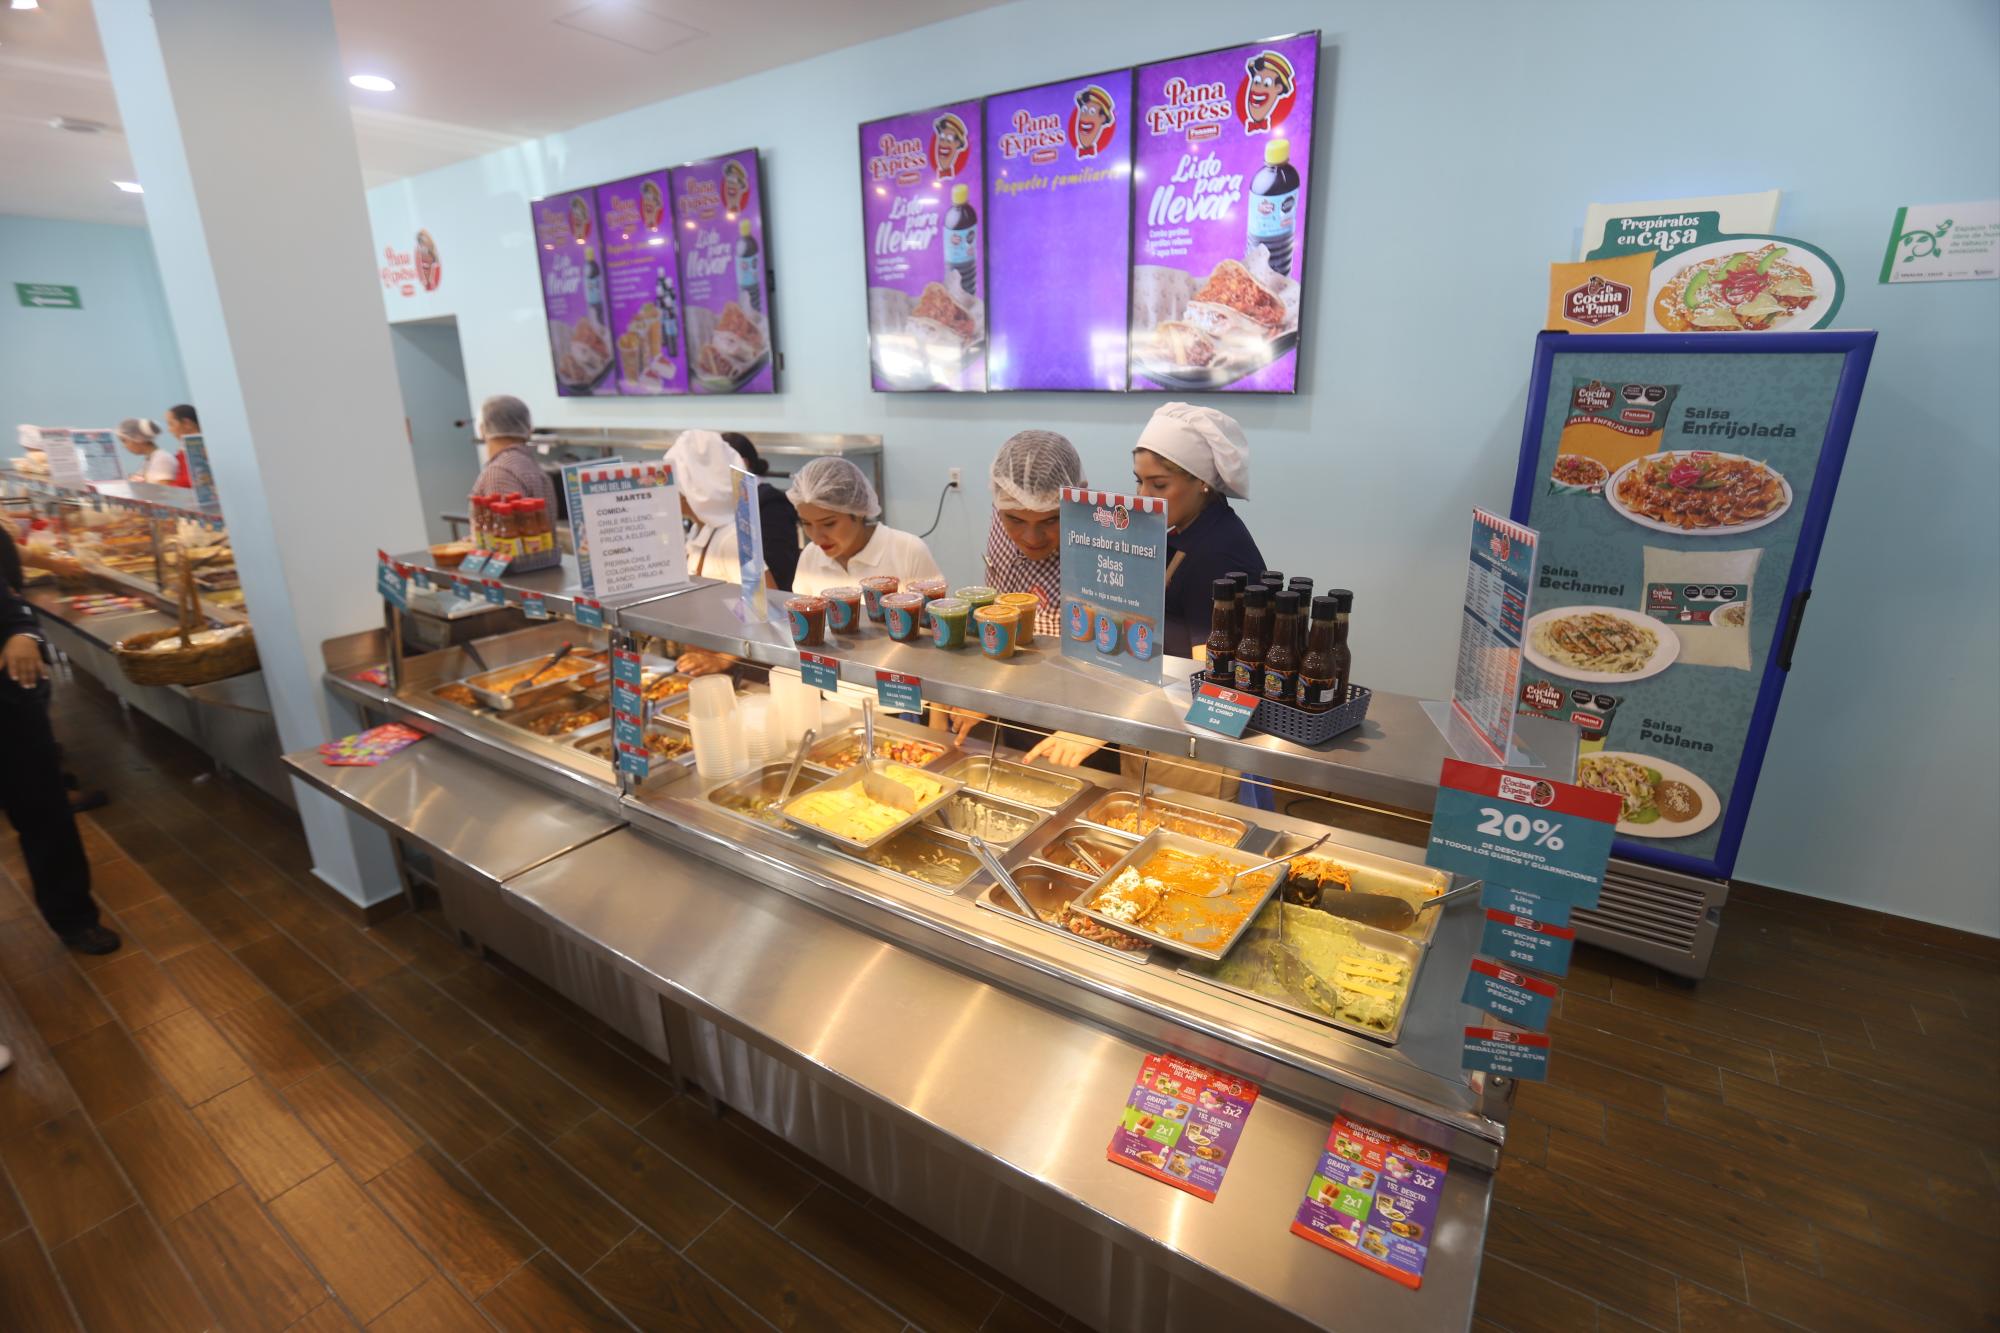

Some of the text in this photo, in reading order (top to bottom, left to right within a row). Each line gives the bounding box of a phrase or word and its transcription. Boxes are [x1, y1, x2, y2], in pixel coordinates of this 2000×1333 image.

[1165, 79, 1224, 105] Pana
[1013, 110, 1059, 133] Pana
[1147, 101, 1231, 134] Express
[880, 134, 922, 156] Pana
[1000, 131, 1064, 157] Express
[869, 154, 926, 179] Express
[1171, 152, 1221, 181] Listo
[995, 175, 1048, 195] Paquetes
[1194, 174, 1242, 200] para
[1148, 184, 1240, 225] llevar
[903, 213, 938, 232] para
[1620, 214, 1699, 230] Prepáralos
[875, 221, 938, 255] llevar
[1617, 228, 1697, 251] en casa
[1572, 291, 1622, 305] Cocina
[1572, 303, 1622, 316] del Pana
[1579, 389, 1610, 398] Cocina
[1684, 407, 1730, 419] Salsa
[1593, 416, 1645, 435] ENFRIJOLADA
[1681, 420, 1796, 438] Enfrijolada
[615, 492, 651, 502] MARTES
[599, 525, 623, 535] ARROZ
[1068, 530, 1156, 558] ¡Ponle sabor a tu mesa!
[1097, 554, 1123, 572] Salsas
[1541, 564, 1578, 577] Salsa
[1096, 569, 1123, 587] 2 x $40
[1539, 576, 1624, 596] Bechamel
[1526, 685, 1559, 699] Cocina
[1197, 696, 1250, 715] SALSA MARISQUERA
[1215, 708, 1233, 716] CHINO
[1641, 718, 1681, 732] Salsa
[1639, 729, 1713, 751] Poblana
[1501, 785, 1530, 797] Express
[1503, 776, 1531, 790] Cocina
[1476, 807, 1564, 850] 20%
[1432, 836, 1445, 844] EN
[1445, 839, 1472, 851] TODOS
[1473, 846, 1489, 856] LOS
[1490, 850, 1521, 864] GUISOS
[1530, 861, 1598, 883] GUARNICIONES
[1482, 842, 1546, 862] DE DESCUENTO
[1501, 928, 1551, 947] CEVICHE DE
[1513, 939, 1536, 950] SOYA
[1484, 979, 1533, 1001] CEVICHE DE
[1487, 987, 1526, 1006] PESCADO
[1481, 1039, 1530, 1052] CEVICHE DE
[1509, 1050, 1522, 1058] DE
[1168, 1062, 1207, 1079] PROMOCIONES
[1173, 1070, 1197, 1082] DEL MES
[1146, 1094, 1167, 1105] GRATIS
[1222, 1105, 1242, 1118] 3x2
[1156, 1124, 1174, 1136] 2x1
[1345, 1121, 1391, 1142] PROMOCIONES
[1352, 1130, 1379, 1144] DEL MES
[1327, 1158, 1350, 1171] GRATIS
[1387, 1181, 1399, 1190] 15%
[1413, 1174, 1435, 1189] 3x2
[1343, 1194, 1362, 1208] 2x1
